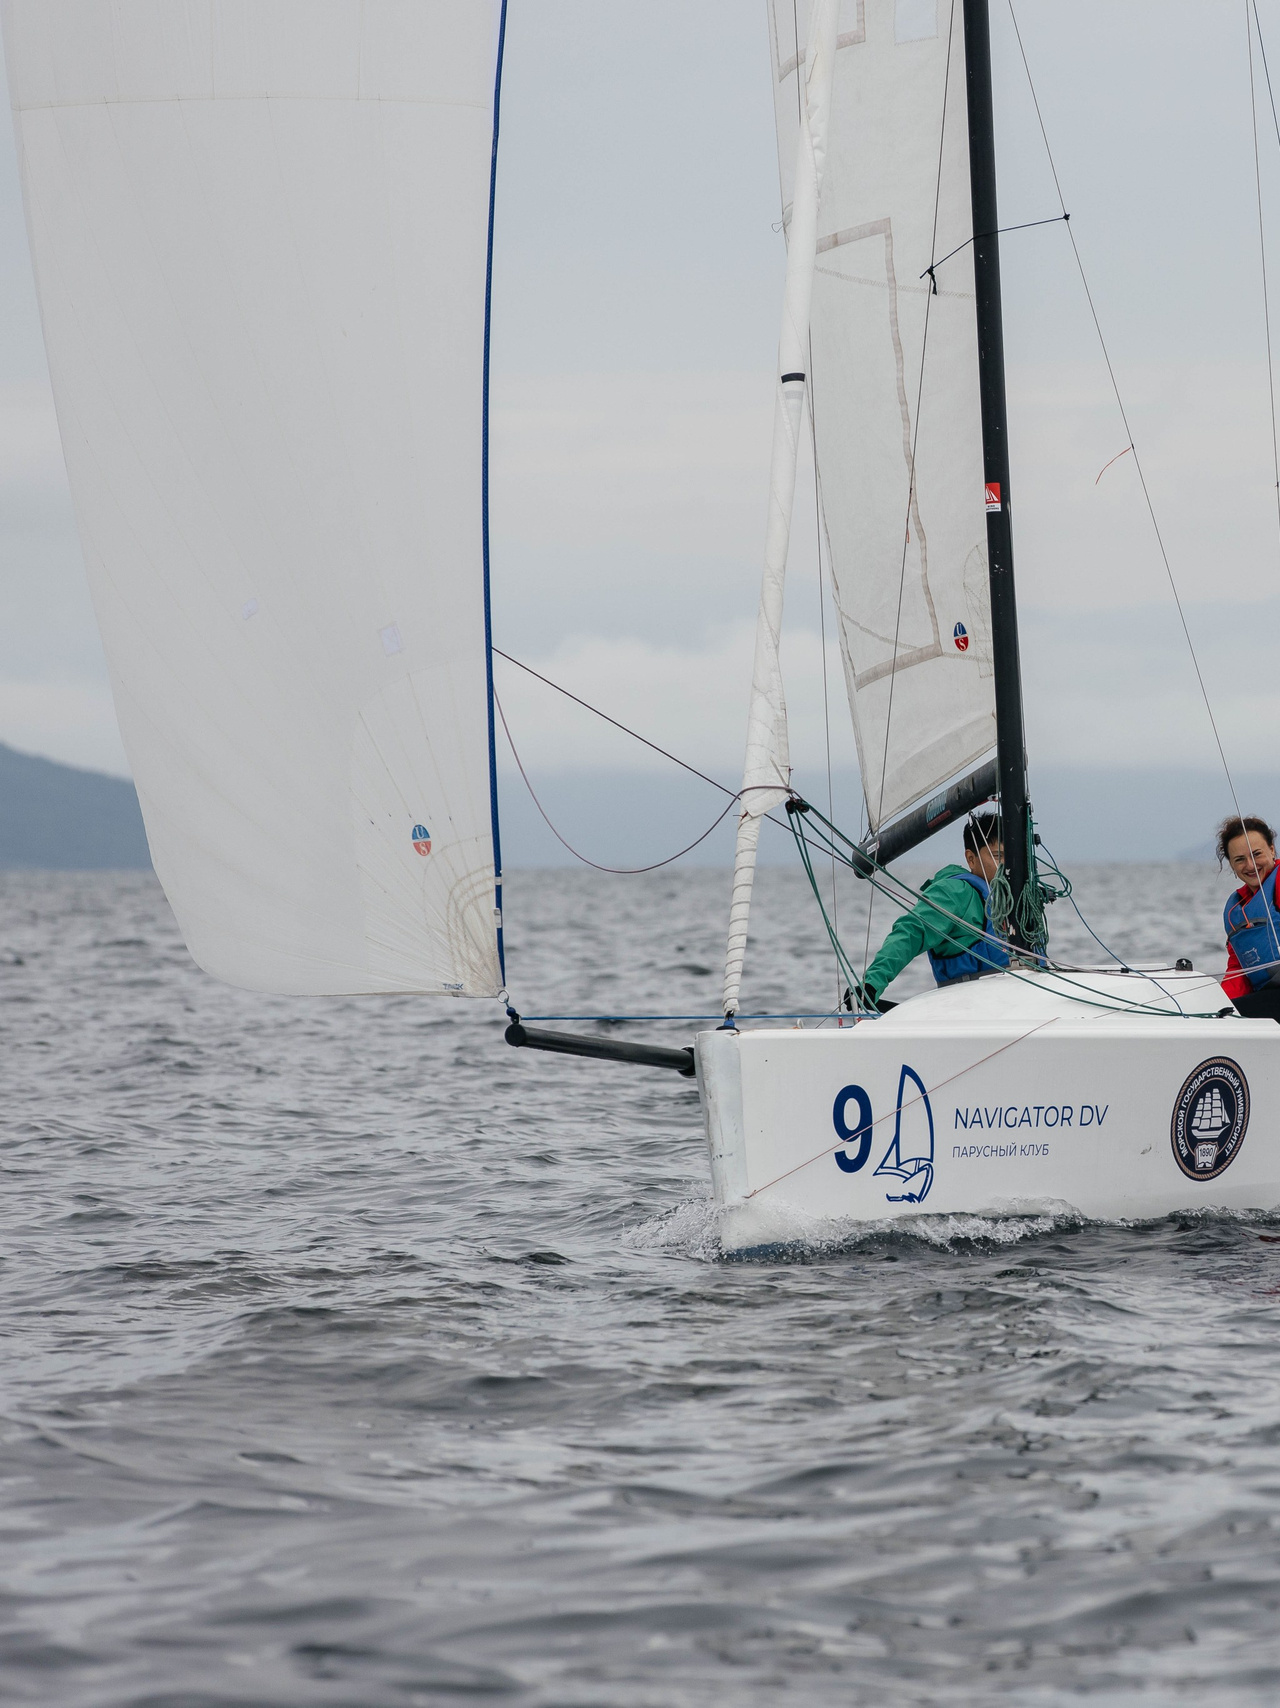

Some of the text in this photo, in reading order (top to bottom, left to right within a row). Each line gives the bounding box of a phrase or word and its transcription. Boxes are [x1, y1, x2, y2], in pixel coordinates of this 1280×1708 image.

[954, 1105, 1109, 1129] NAVIGATOR DV
[1177, 1066, 1244, 1158] МОРСКОЙ ГОСУДАРСТВЕННЫЙ УНИВЕРСИТЕТ
[833, 1084, 873, 1173] 9
[952, 1142, 1050, 1158] ПАРУСНЫЙ КЛУБ
[1199, 1147, 1214, 1157] 1890
